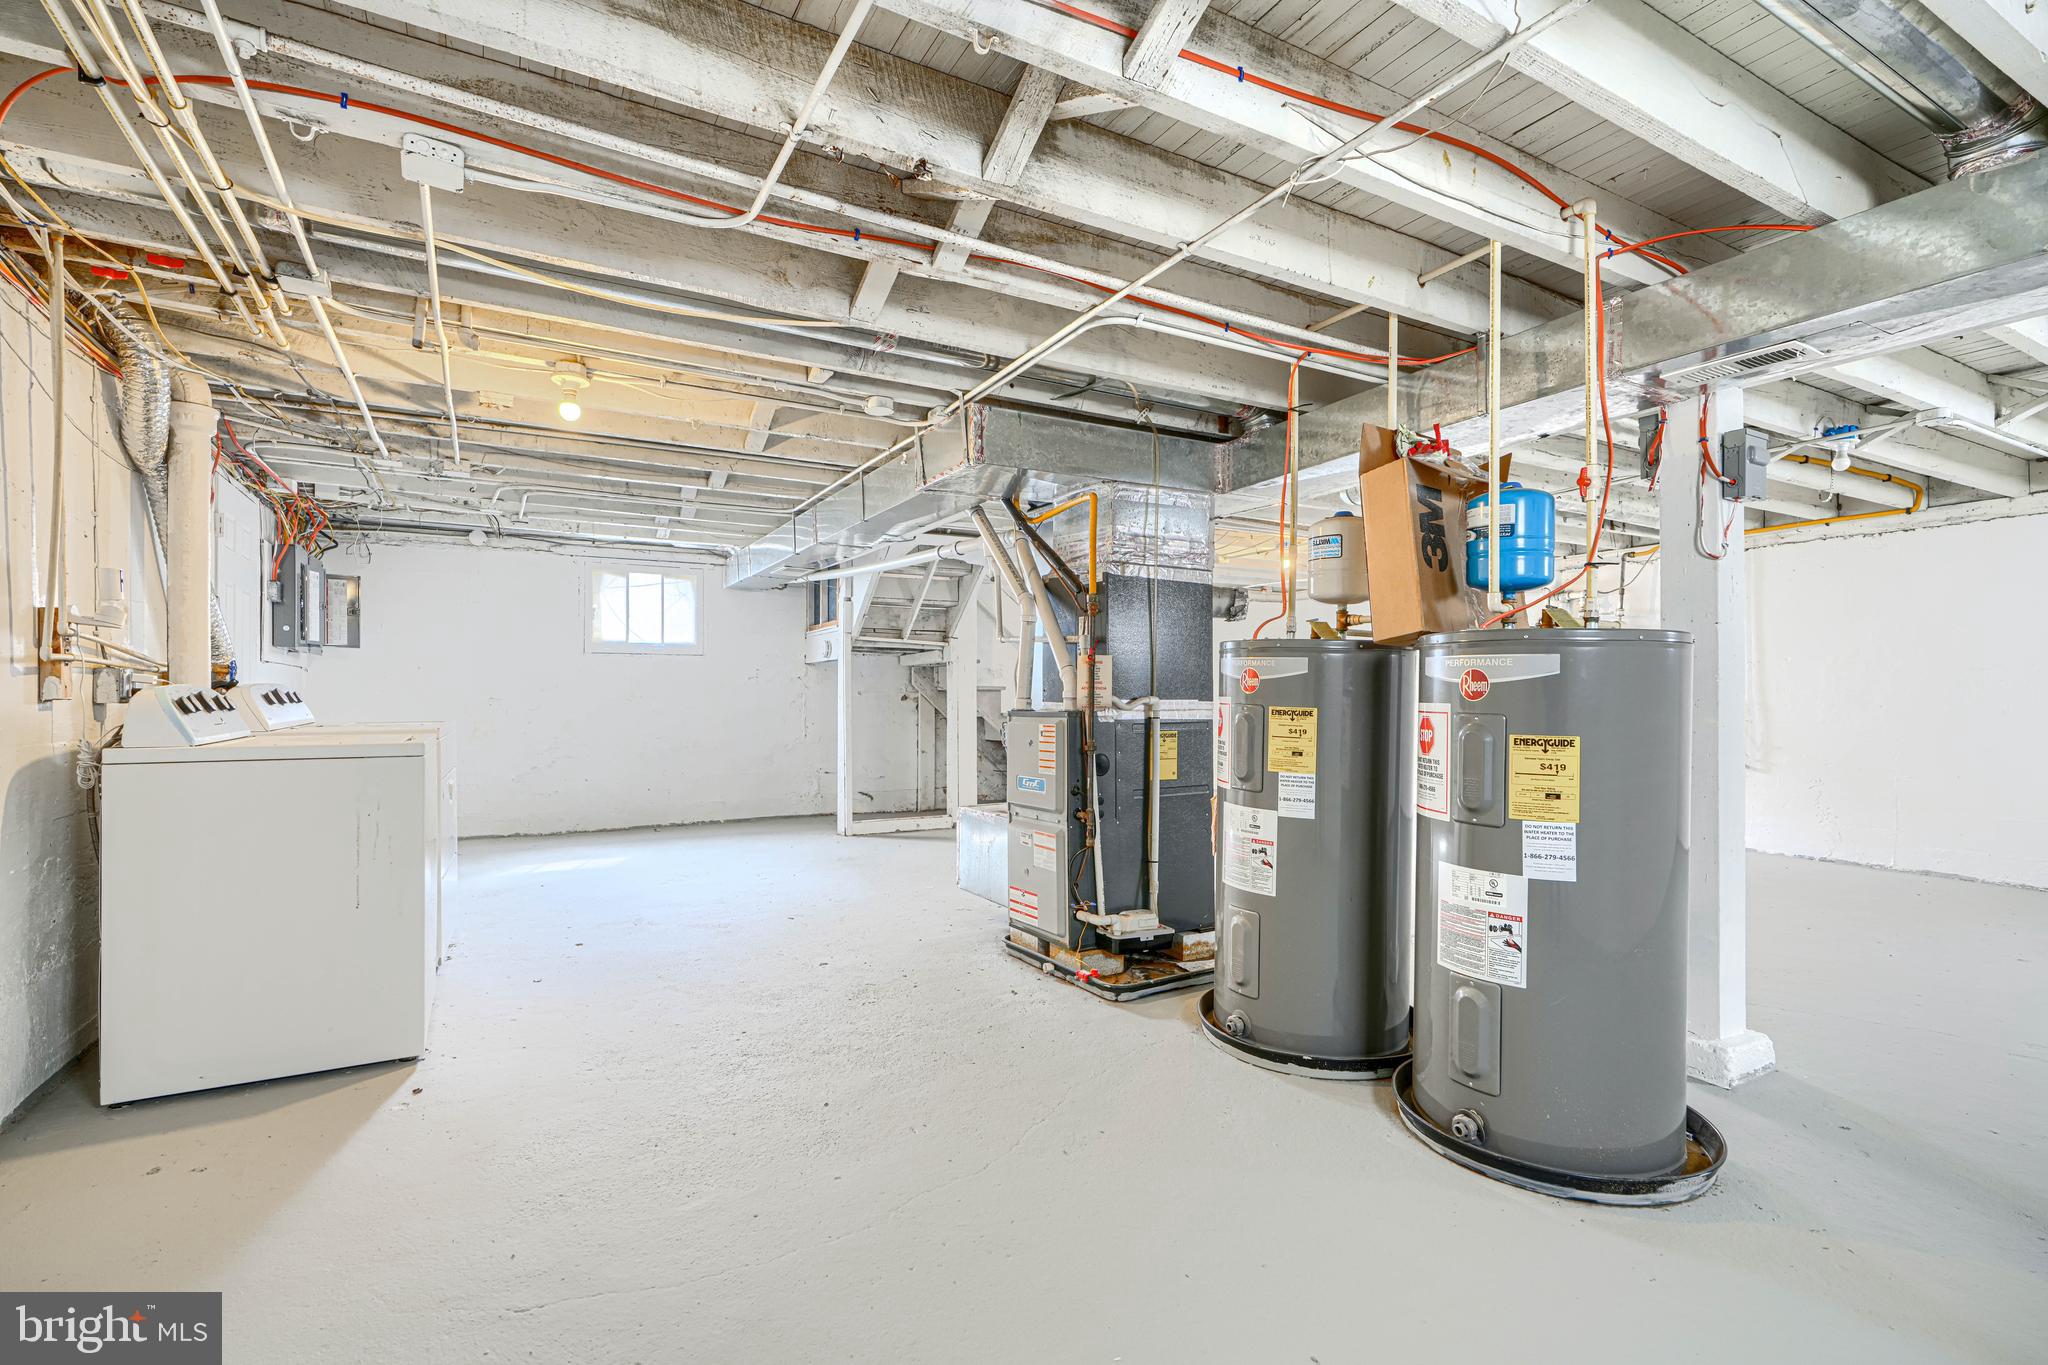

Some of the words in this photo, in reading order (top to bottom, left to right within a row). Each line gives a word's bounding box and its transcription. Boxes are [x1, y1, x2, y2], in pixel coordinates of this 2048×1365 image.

[1415, 483, 1448, 572] 3M
[1445, 657, 1513, 667] PERFORMANCE
[1461, 669, 1488, 696] Rheem
[1271, 709, 1314, 718] ENERGYGUIDE
[1420, 729, 1432, 742] STOP
[1513, 737, 1576, 749] ENERGYGUIDE
[1539, 763, 1567, 773] $419
[1524, 853, 1576, 862] 1-866-279-4566
[1495, 913, 1522, 921] DANGER
